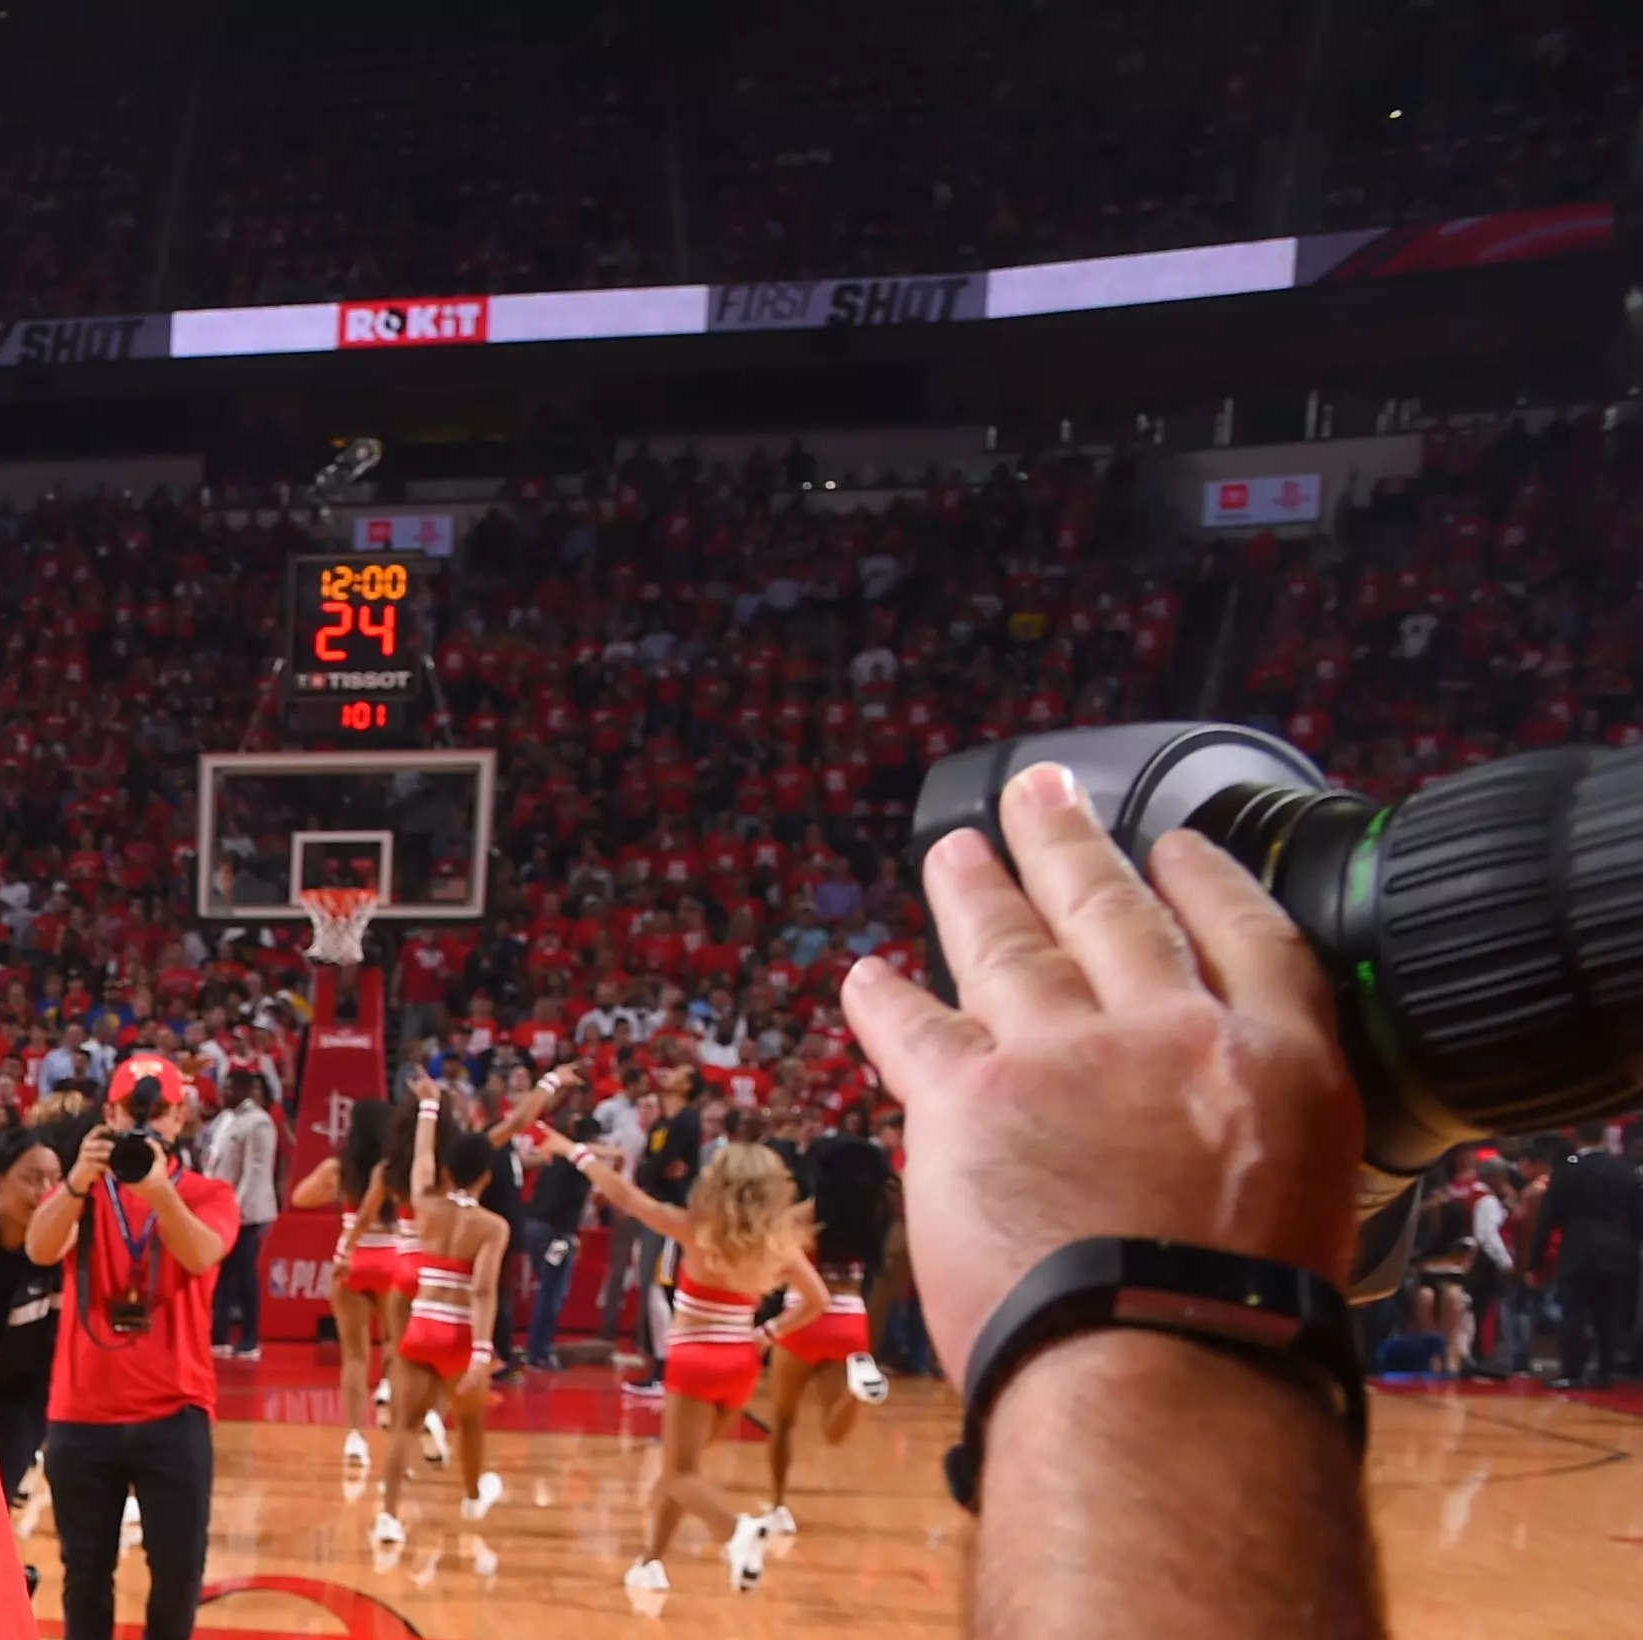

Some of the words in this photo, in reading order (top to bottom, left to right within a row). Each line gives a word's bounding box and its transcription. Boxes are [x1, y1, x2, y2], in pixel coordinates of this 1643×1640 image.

[717, 282, 813, 321] FIRST
[826, 277, 970, 326] SHOT
[18, 318, 144, 364] SHOT
[320, 564, 407, 601] 12:00
[313, 602, 397, 662] 24
[328, 670, 412, 690] TISSOT
